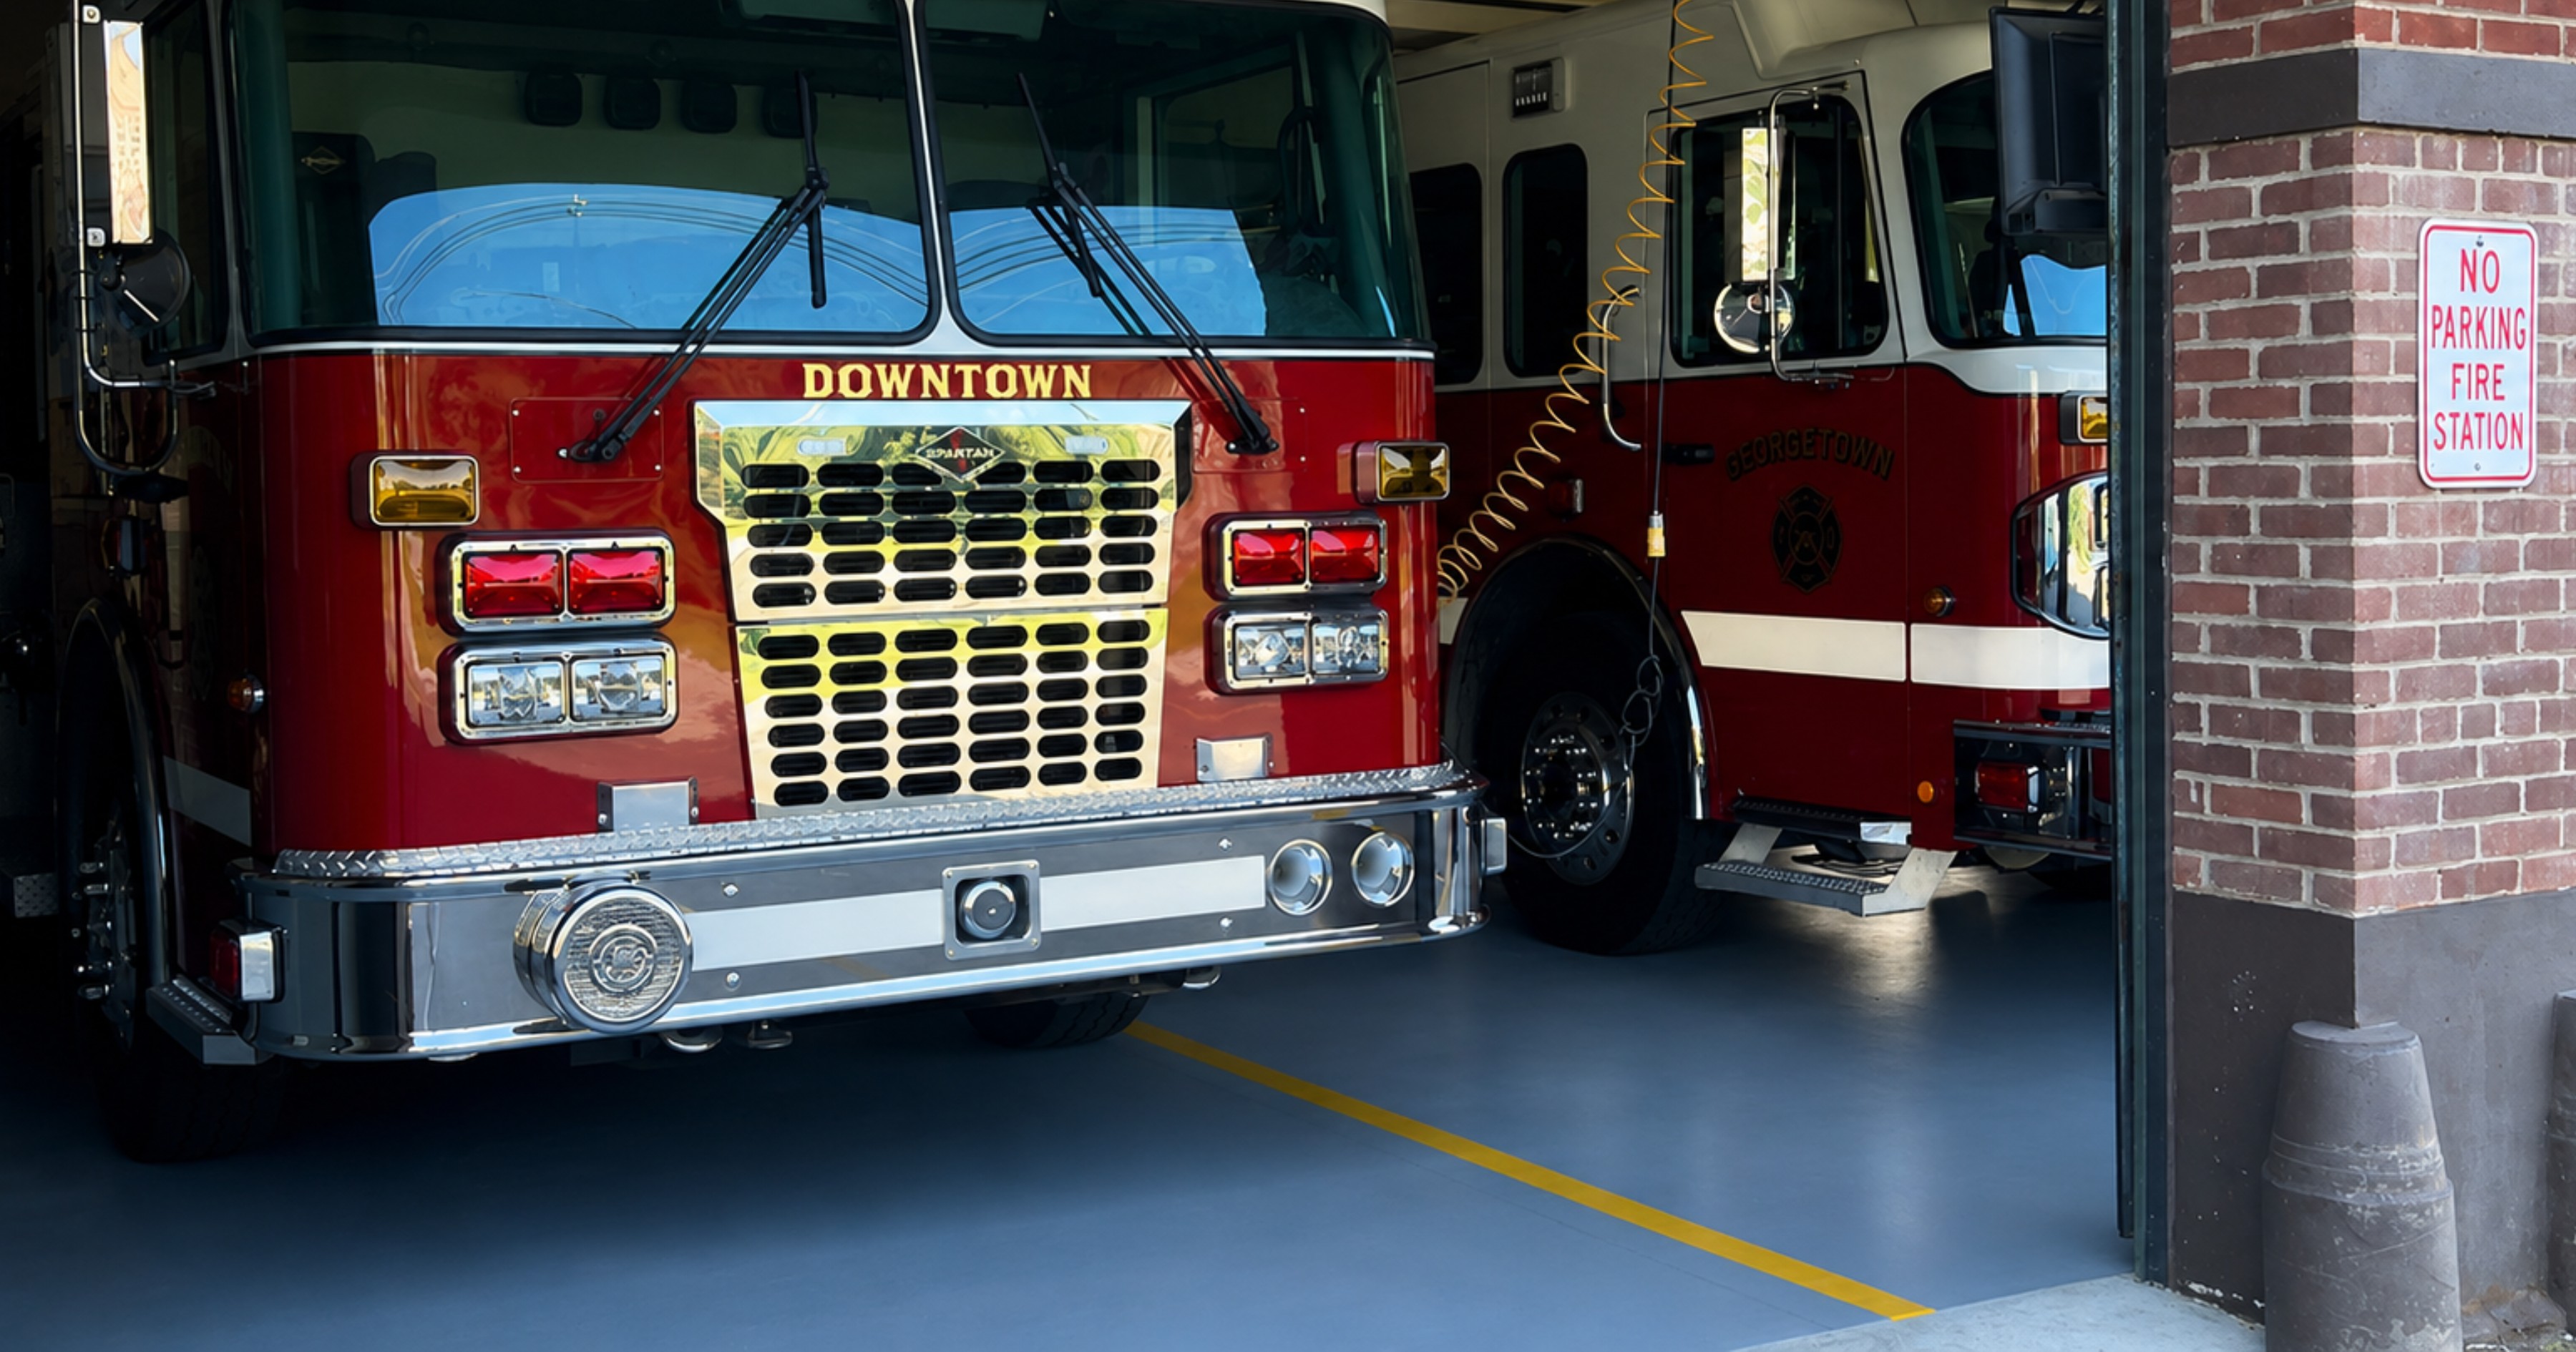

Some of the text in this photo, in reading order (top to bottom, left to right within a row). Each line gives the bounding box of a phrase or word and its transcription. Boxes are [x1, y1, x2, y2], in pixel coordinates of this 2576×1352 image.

[2460, 248, 2500, 294] NO
[2431, 305, 2527, 351] PARKING
[803, 363, 1091, 398] DOWNTOWN
[2451, 363, 2506, 401] FIRE
[2434, 411, 2524, 451] STATION
[1725, 428, 1894, 481] GEORGETOWN
